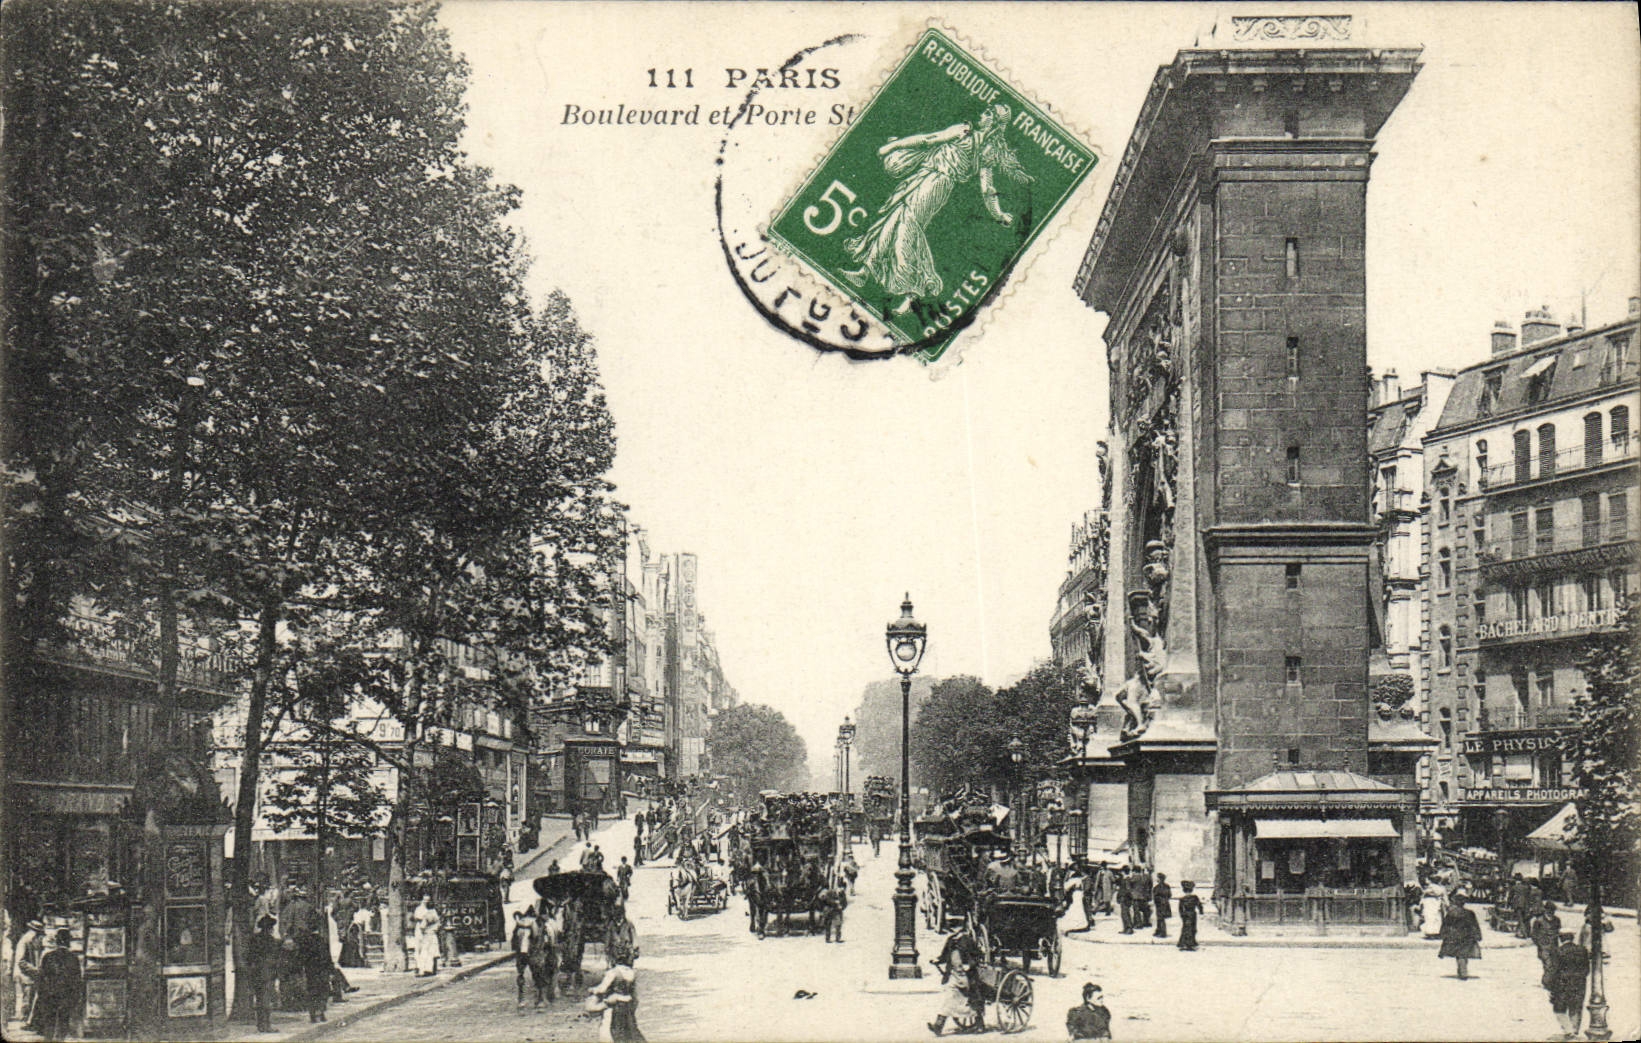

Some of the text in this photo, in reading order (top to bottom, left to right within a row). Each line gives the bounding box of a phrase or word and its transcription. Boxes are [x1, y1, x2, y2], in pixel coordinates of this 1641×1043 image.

[1012, 111, 1085, 174] FRANÇAISE
[1465, 740, 1484, 753] LE
[1466, 789, 1521, 800] APPAREILS
